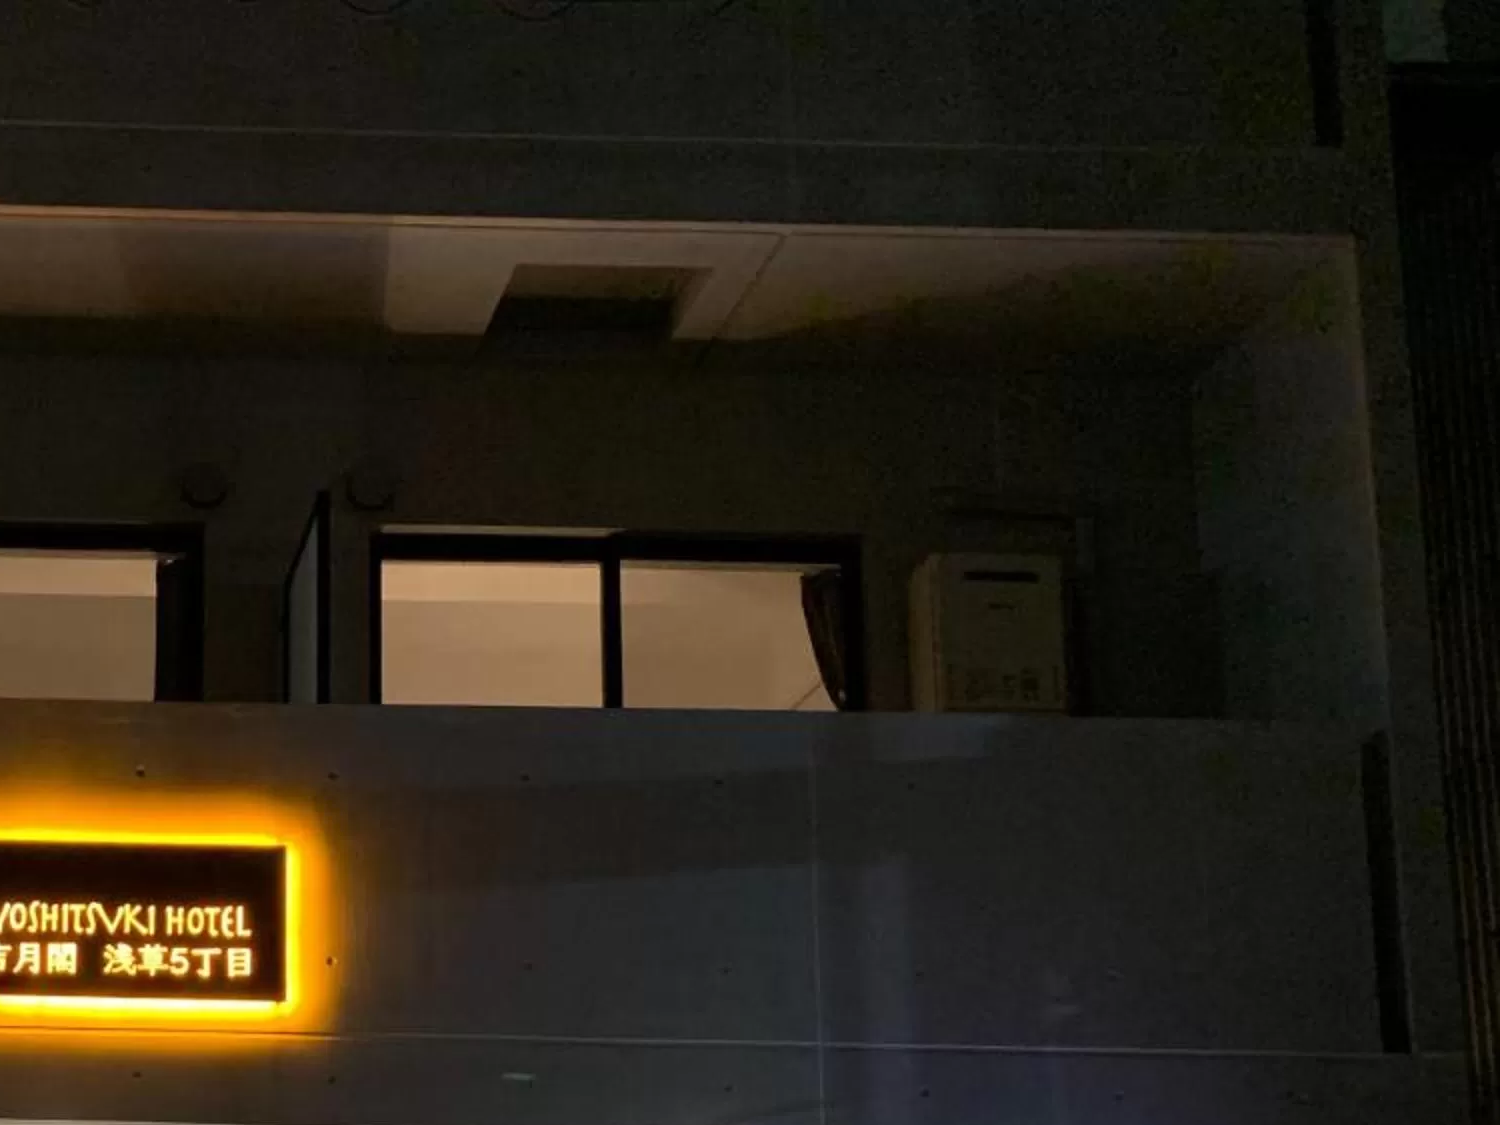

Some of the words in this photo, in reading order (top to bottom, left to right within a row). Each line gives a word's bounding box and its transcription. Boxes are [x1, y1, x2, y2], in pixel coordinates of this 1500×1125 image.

[166, 904, 253, 937] HOTEL
[103, 942, 253, 978] 浅草5丁目
